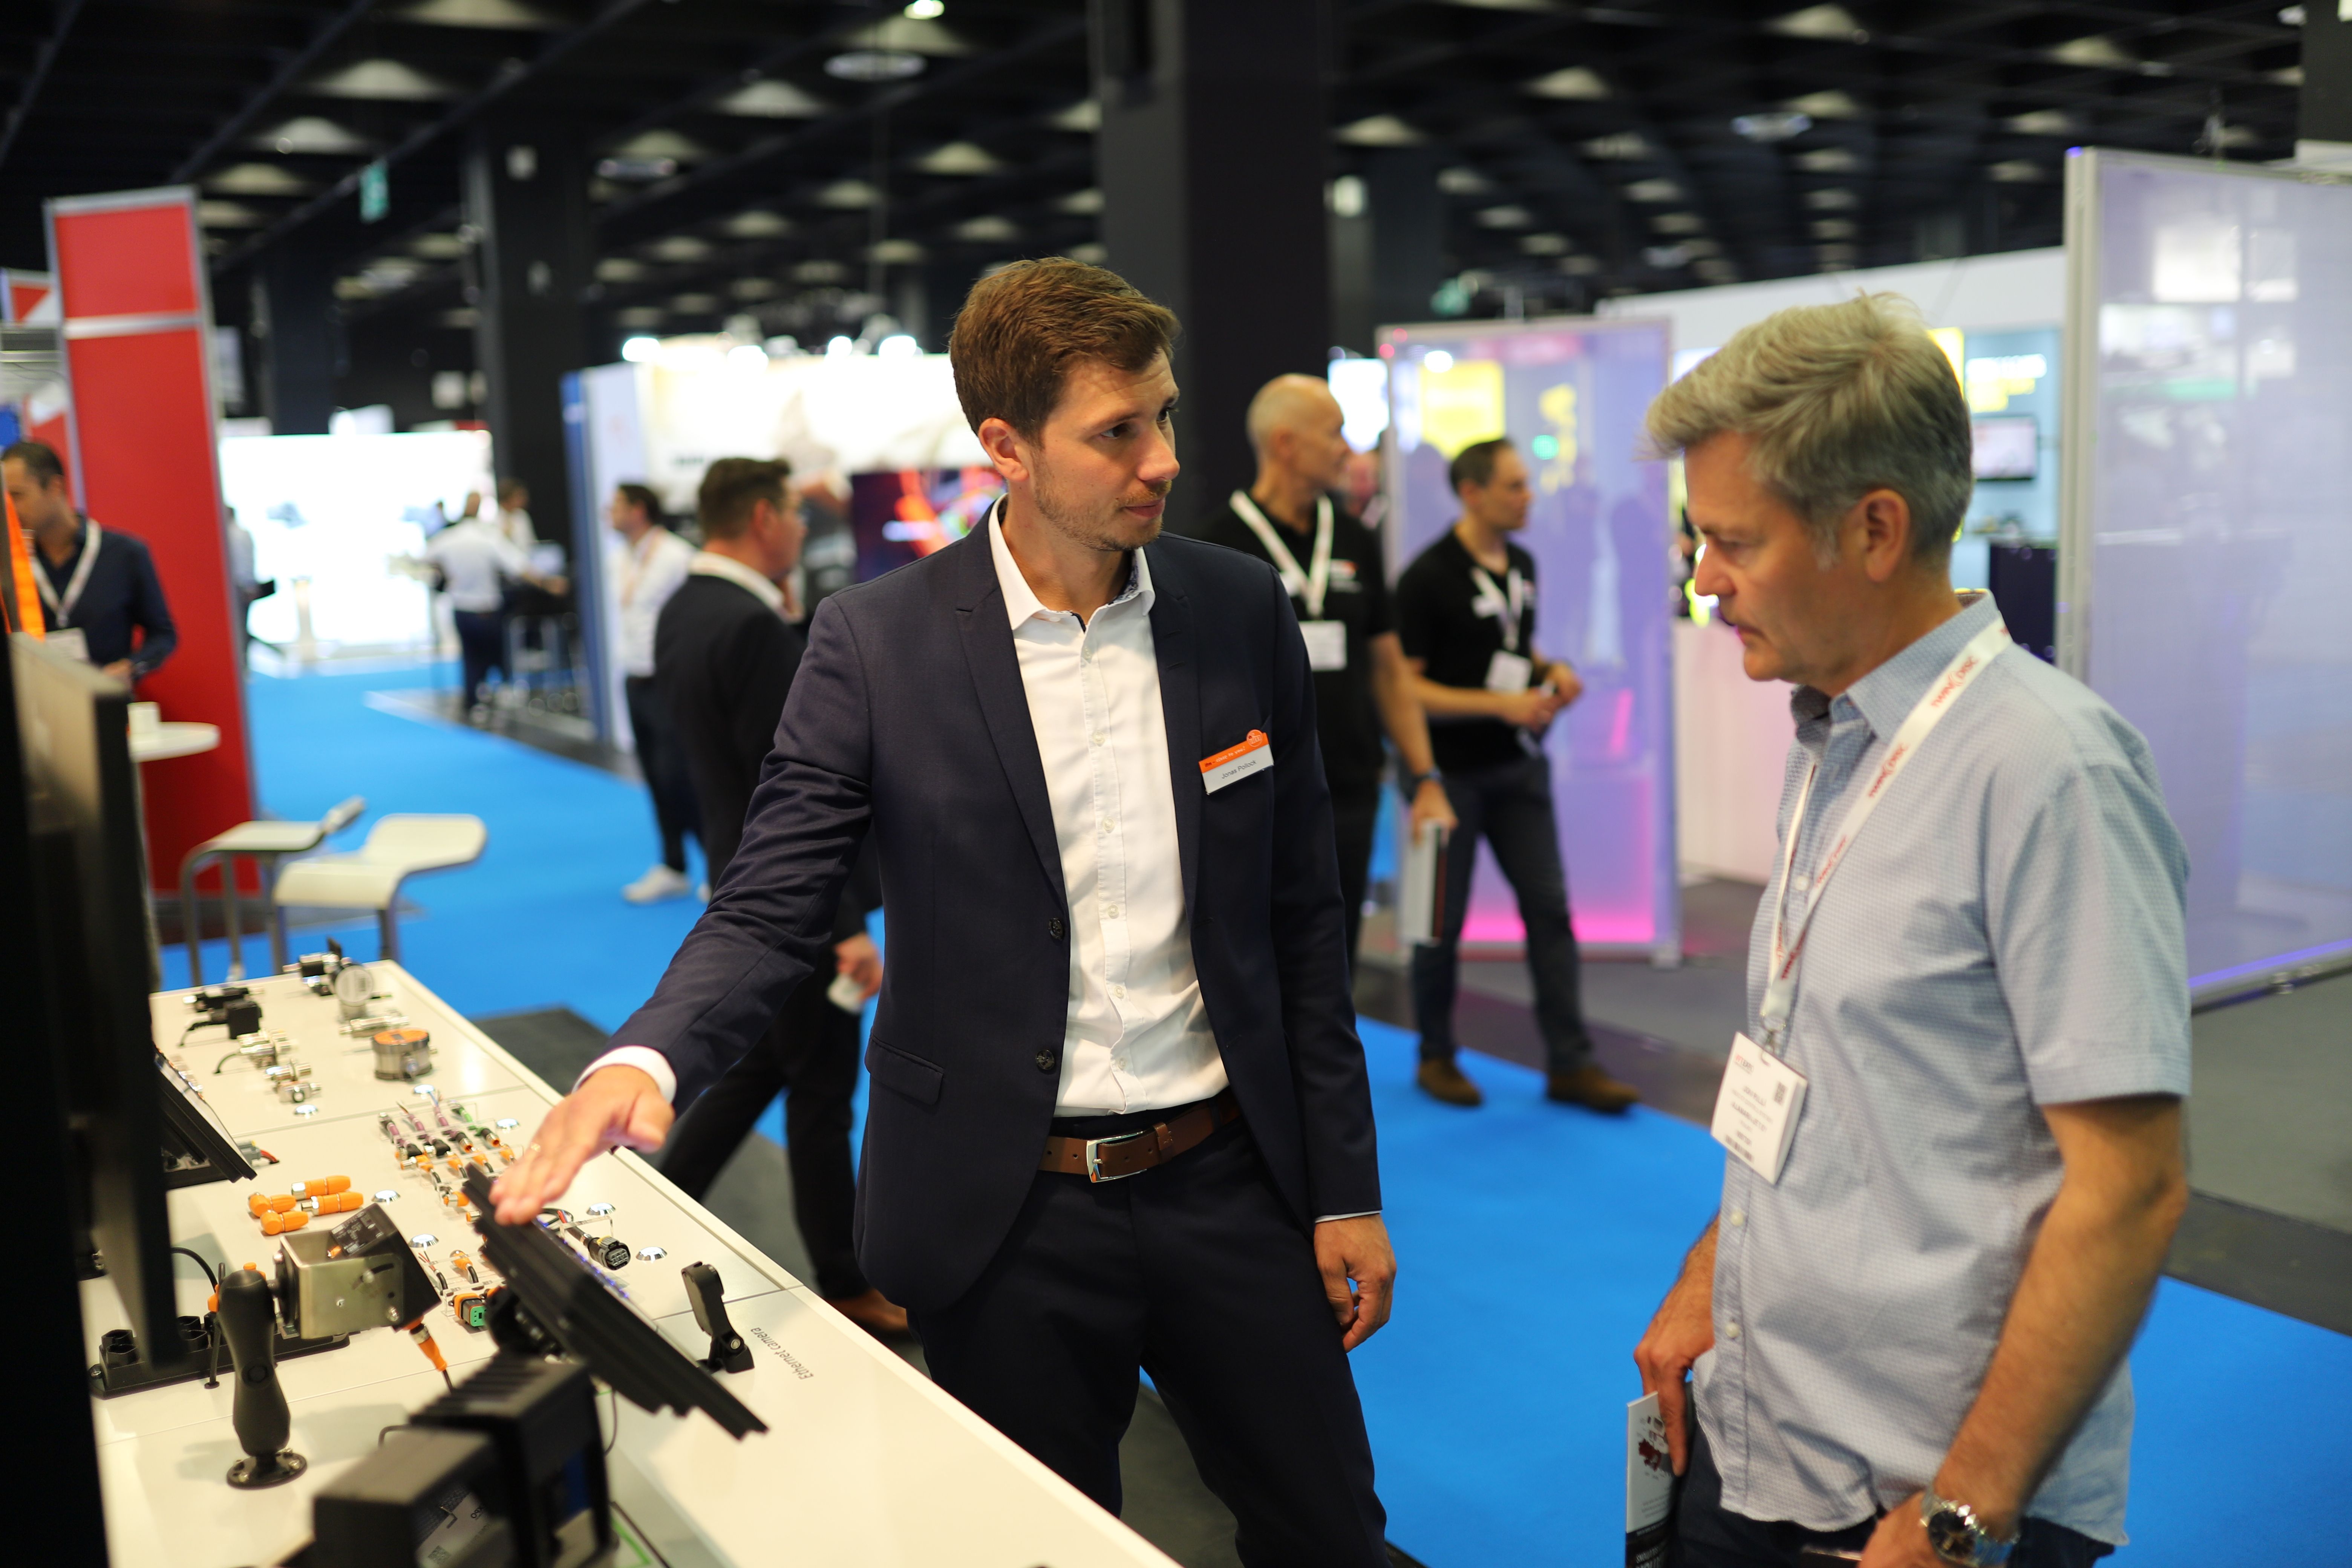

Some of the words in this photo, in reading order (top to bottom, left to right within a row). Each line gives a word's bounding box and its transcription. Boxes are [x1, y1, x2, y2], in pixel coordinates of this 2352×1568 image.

[1222, 769, 1237, 779] Jonas
[1238, 760, 1257, 772] Pollock
[750, 1327, 781, 1350] camera
[774, 1350, 814, 1380] Ethernet
